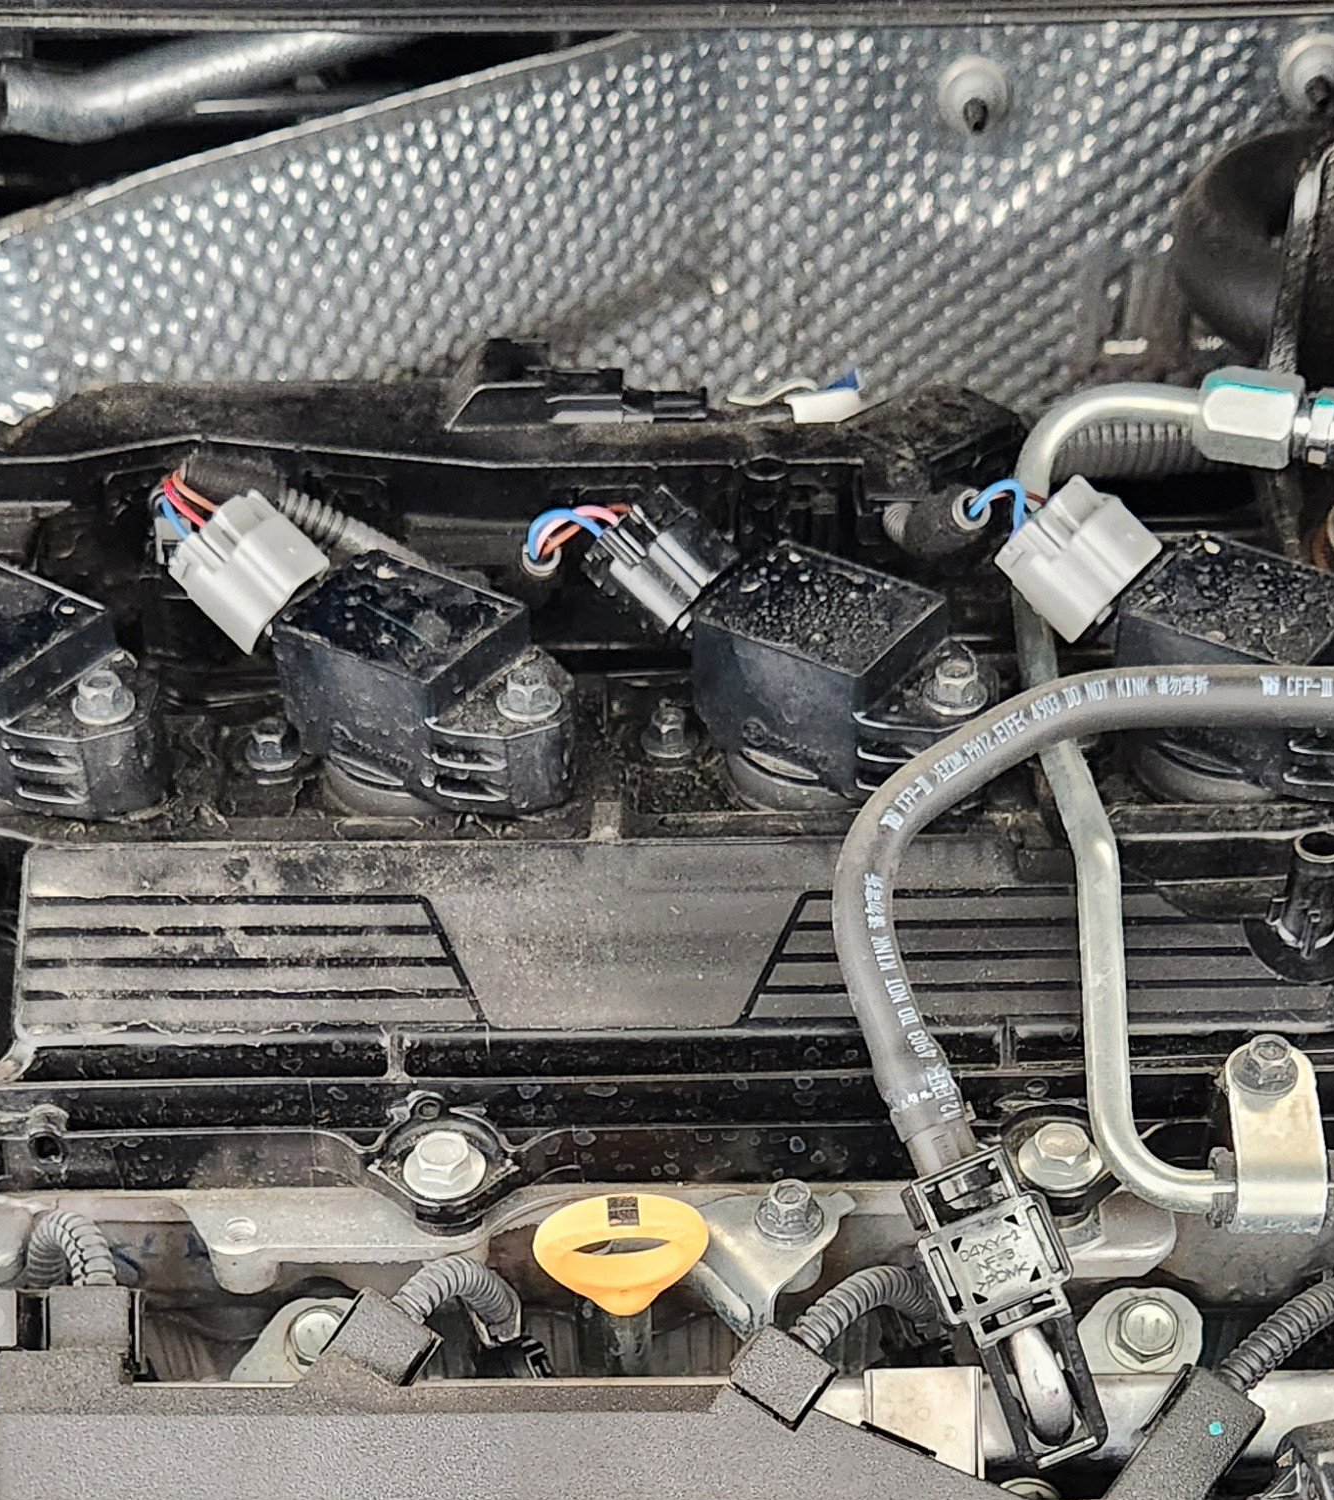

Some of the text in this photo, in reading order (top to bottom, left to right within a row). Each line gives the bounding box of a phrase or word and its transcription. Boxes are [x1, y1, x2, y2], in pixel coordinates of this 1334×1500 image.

[1030, 694, 1060, 721] 4903
[1062, 687, 1082, 710] DO
[1085, 679, 1109, 701] NOT
[1116, 676, 1150, 698] KINK
[870, 935, 899, 972] KINK
[884, 978, 911, 1004] NOT
[897, 1006, 919, 1028] DO
[907, 1029, 938, 1060] 4903
